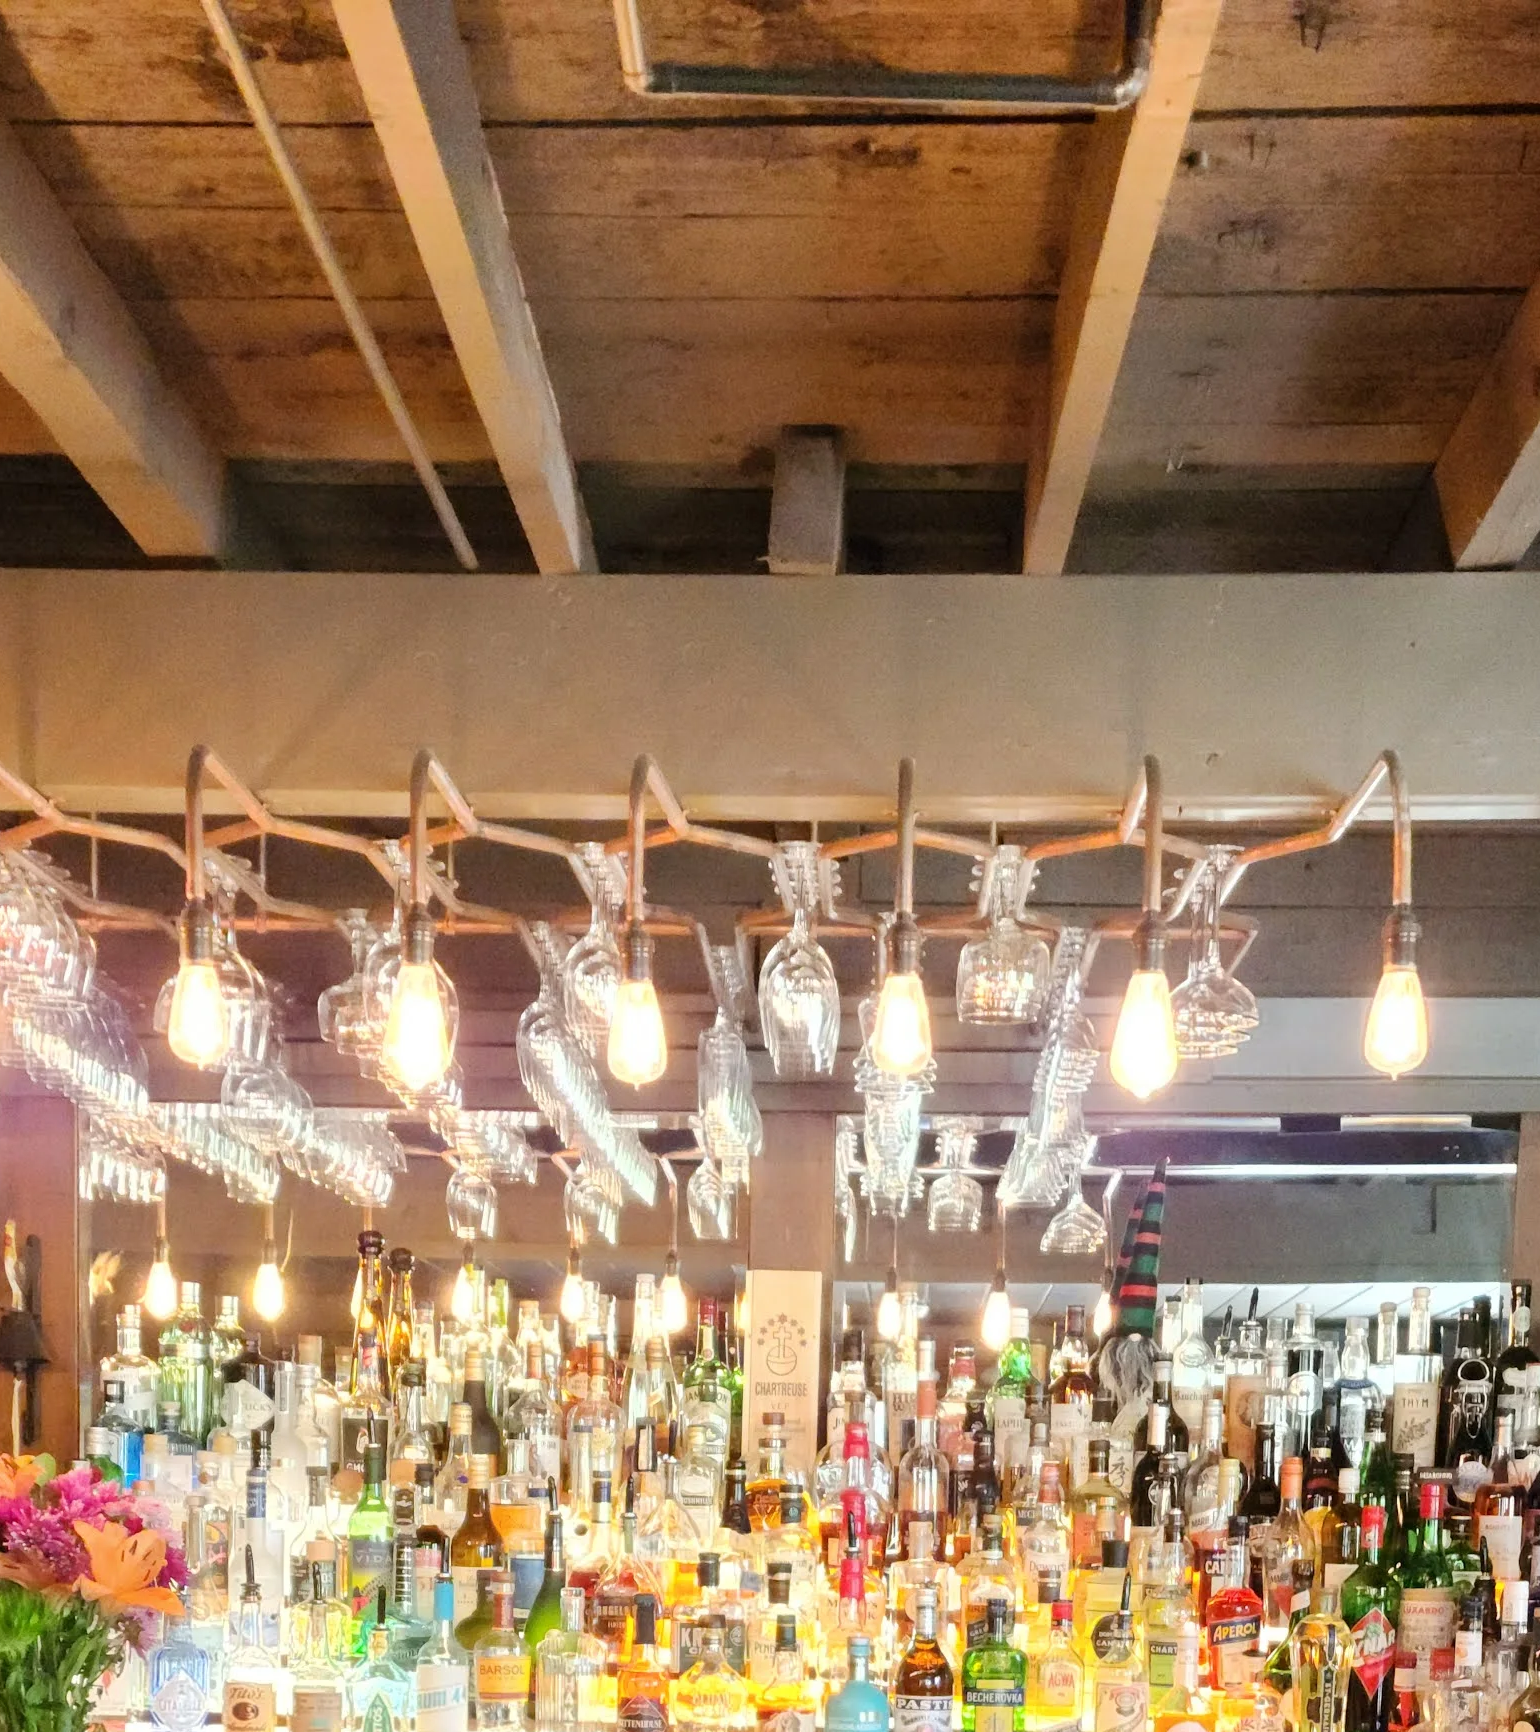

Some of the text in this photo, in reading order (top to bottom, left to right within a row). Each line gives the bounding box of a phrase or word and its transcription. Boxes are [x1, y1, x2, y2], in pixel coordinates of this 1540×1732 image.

[755, 1381, 809, 1397] CHARTREUSE
[1402, 1398, 1429, 1409] THYM
[354, 1554, 393, 1564] VIDA
[1212, 1622, 1258, 1643] APEROL
[1150, 1644, 1179, 1655] CHART
[479, 1664, 526, 1676] BARSOL
[1048, 1672, 1075, 1689] AGWA
[229, 1686, 265, 1700] Tito's
[966, 1691, 1023, 1704] BECHEROVKA
